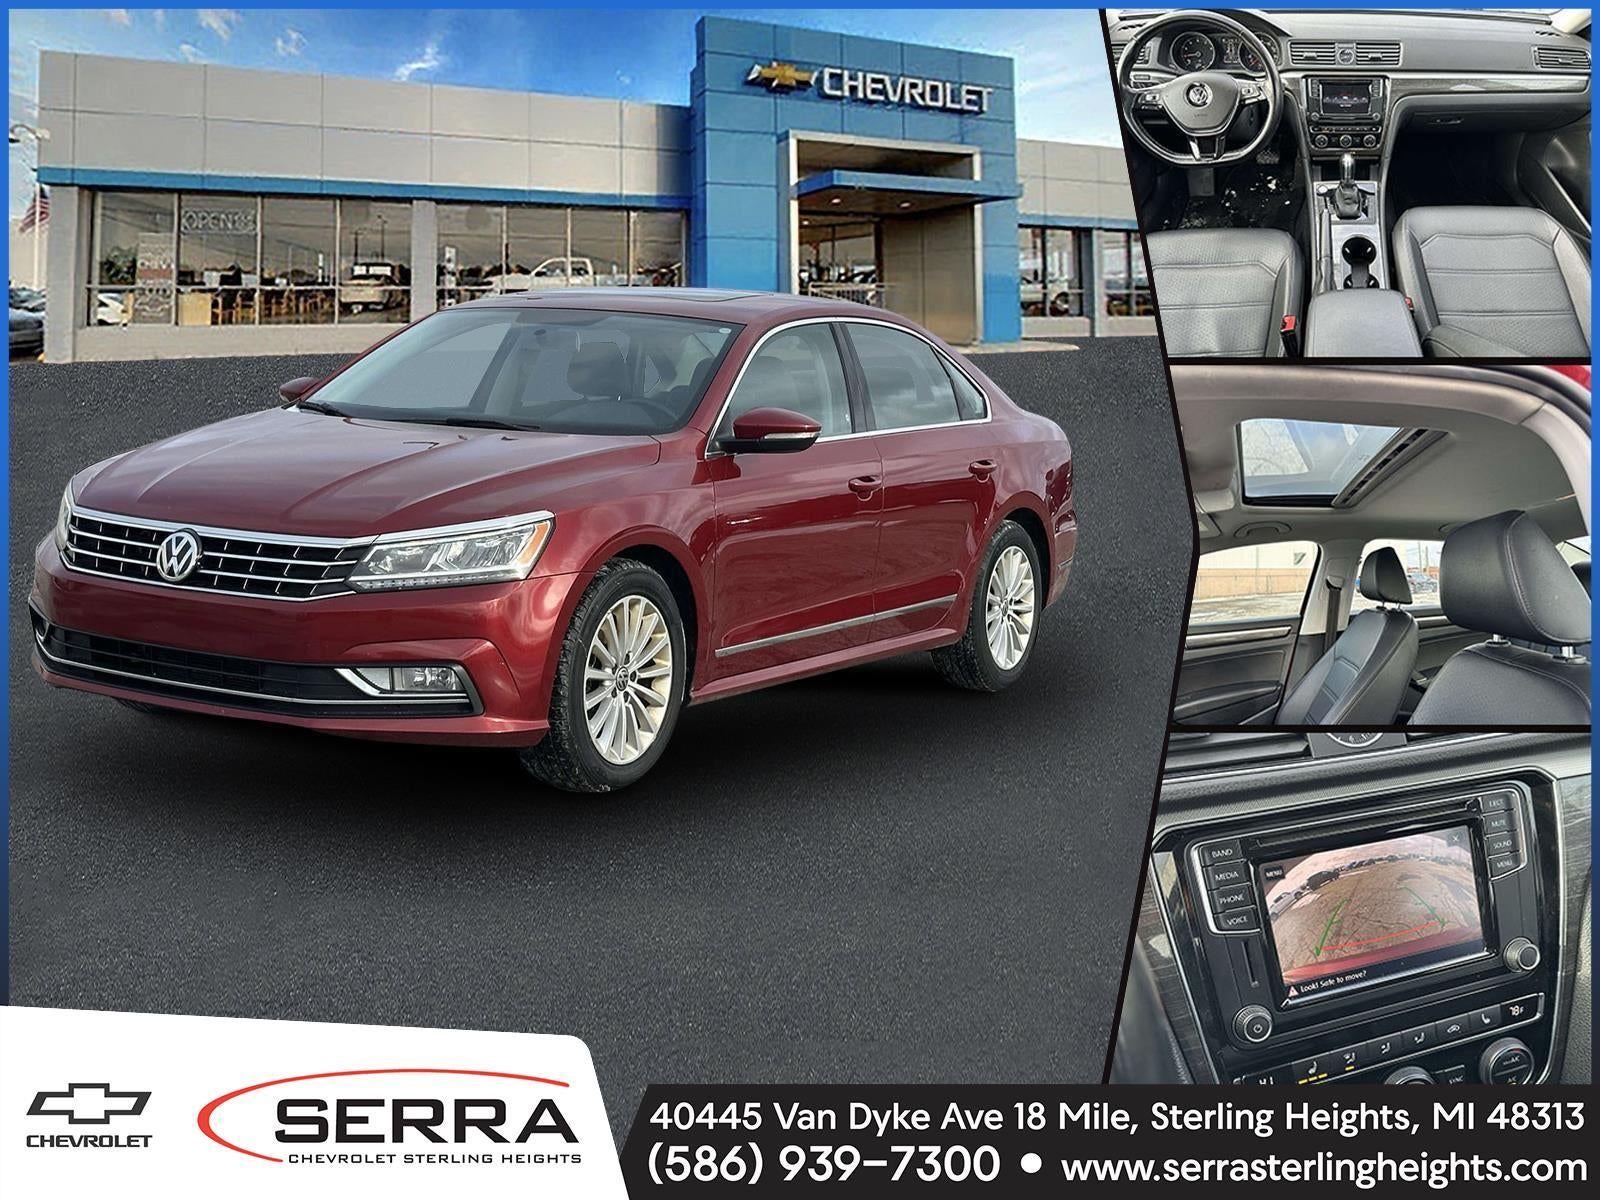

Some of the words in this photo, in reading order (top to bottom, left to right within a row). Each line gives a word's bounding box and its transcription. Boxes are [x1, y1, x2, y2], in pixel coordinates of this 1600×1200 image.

[823, 67, 993, 112] CHEVROLET
[1211, 848, 1233, 858] BAND
[1214, 871, 1240, 881] MEDIA
[1219, 893, 1245, 905] PHONE
[1226, 915, 1248, 926] VOICE
[1300, 981, 1319, 993] Look!
[1319, 978, 1336, 989] Safe
[1336, 976, 1344, 984] to
[1345, 970, 1367, 981] move?
